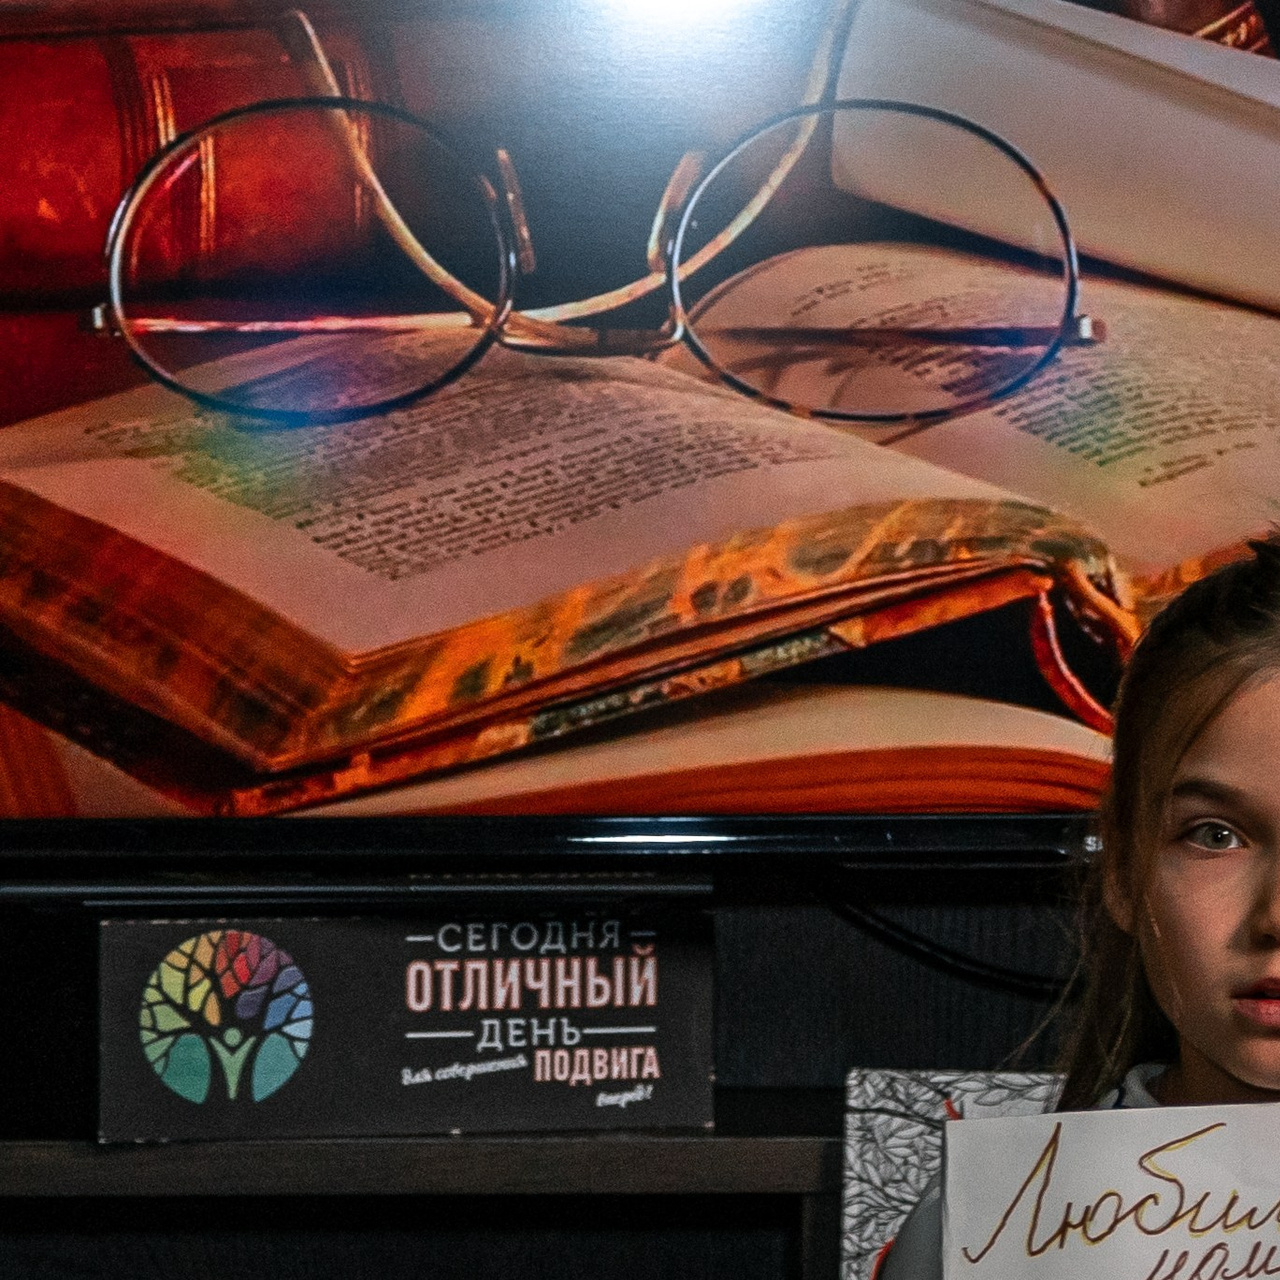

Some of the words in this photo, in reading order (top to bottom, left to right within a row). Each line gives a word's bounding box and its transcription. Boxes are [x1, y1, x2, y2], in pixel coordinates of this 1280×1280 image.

[437, 921, 621, 954] СЕГОДНЯ
[406, 943, 657, 1011] ОТЛИЧНЫЙ
[476, 1017, 581, 1051] ДЕНЬ
[533, 1046, 661, 1086] ПОДВИГА
